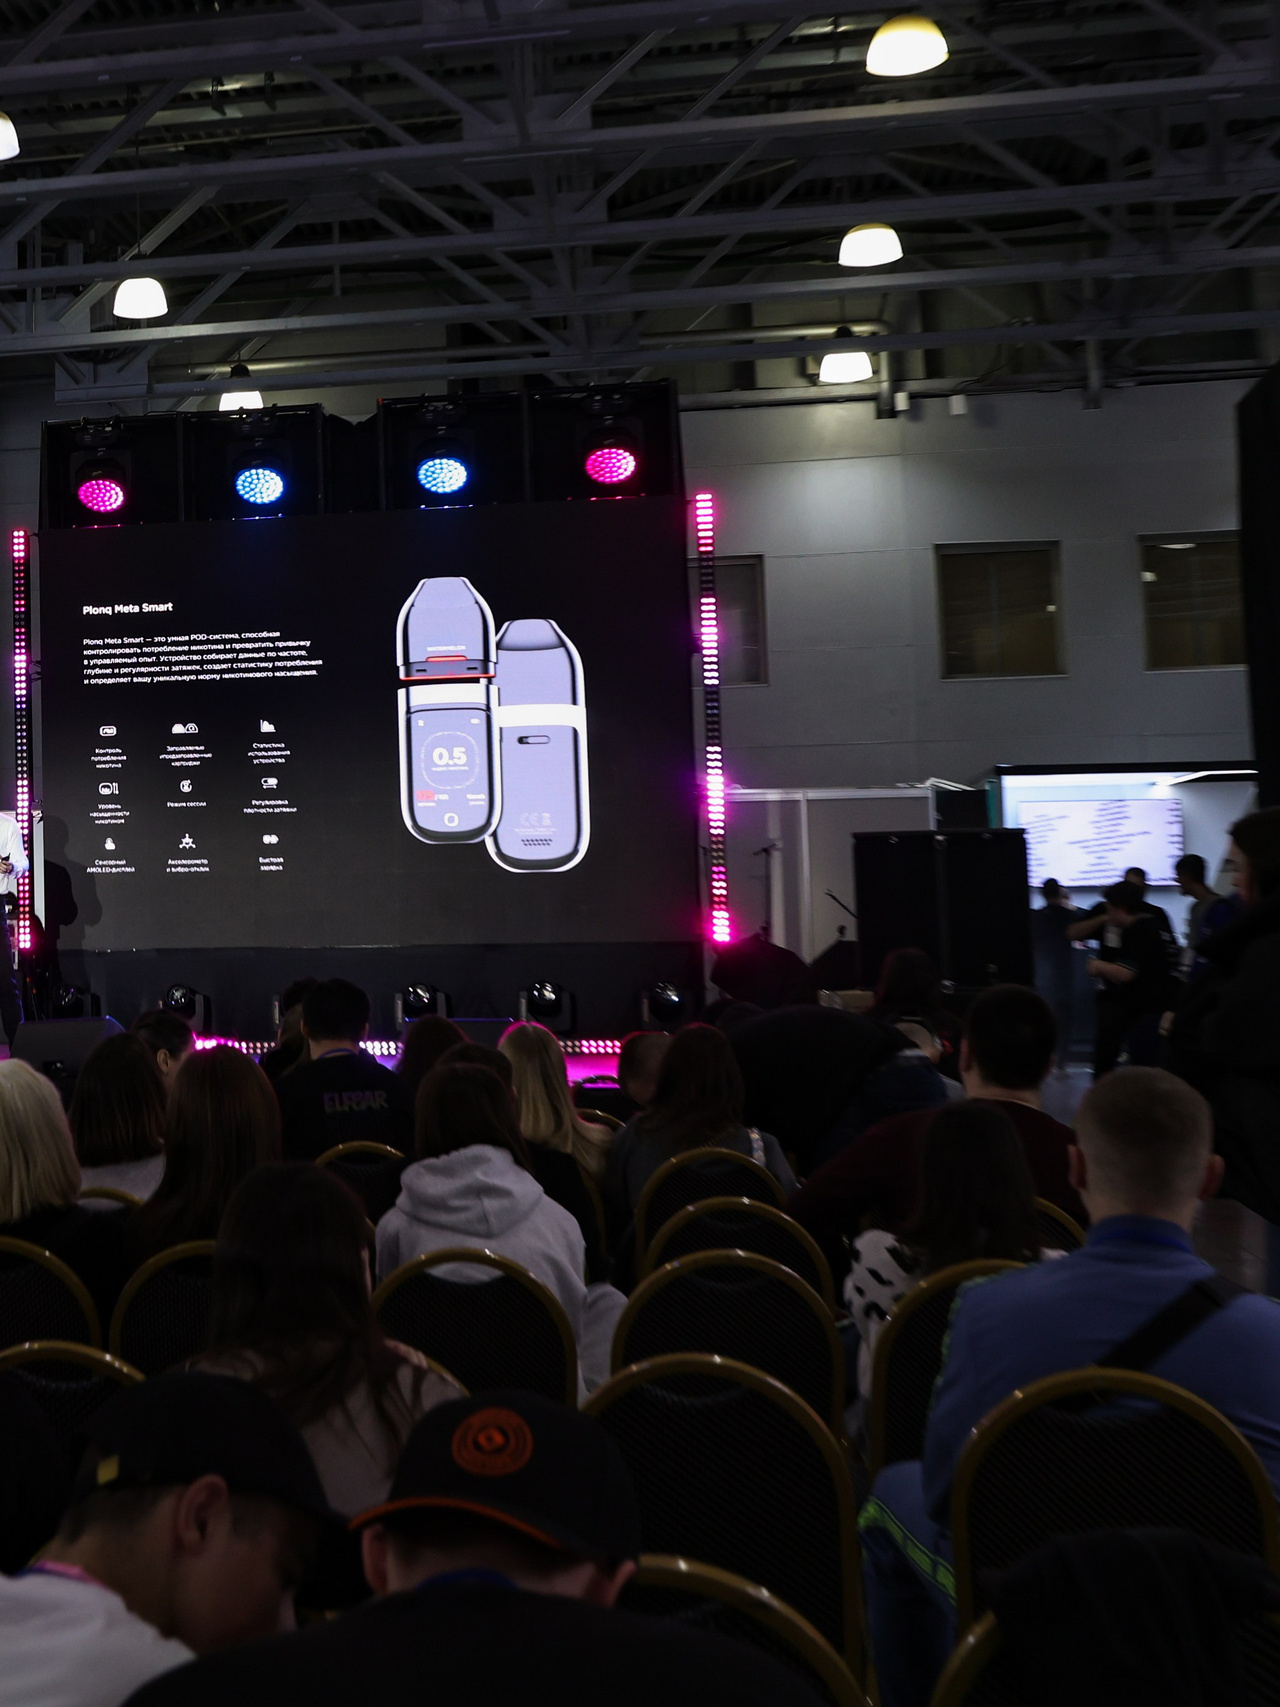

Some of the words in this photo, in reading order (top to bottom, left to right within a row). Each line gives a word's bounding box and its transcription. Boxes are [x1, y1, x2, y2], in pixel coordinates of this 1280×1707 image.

[82, 604, 112, 616] Plonq
[114, 603, 140, 614] Meta
[141, 601, 173, 613] Smart
[83, 638, 103, 646] Plonq
[104, 637, 122, 645] Meta
[123, 636, 144, 645] Smart
[167, 635, 189, 643] умная
[241, 630, 281, 639] способная
[83, 647, 141, 656] контролировать
[142, 645, 189, 654] потребление
[231, 641, 274, 650] превратить
[275, 639, 312, 648] привычку
[89, 656, 137, 666] управляемый
[159, 653, 202, 663] Устройство
[202, 651, 237, 661] собирает
[238, 651, 266, 659] данные
[83, 667, 112, 676] глубине
[120, 665, 170, 675] регулярности
[203, 662, 232, 670] создает
[232, 660, 274, 669] статистику
[274, 658, 323, 667] потребления
[90, 676, 132, 685] определяет
[133, 675, 152, 683] вашу
[153, 673, 197, 684] уникальную
[197, 672, 221, 681] норму
[222, 670, 273, 679] никотинового
[432, 746, 468, 766] 0.5
